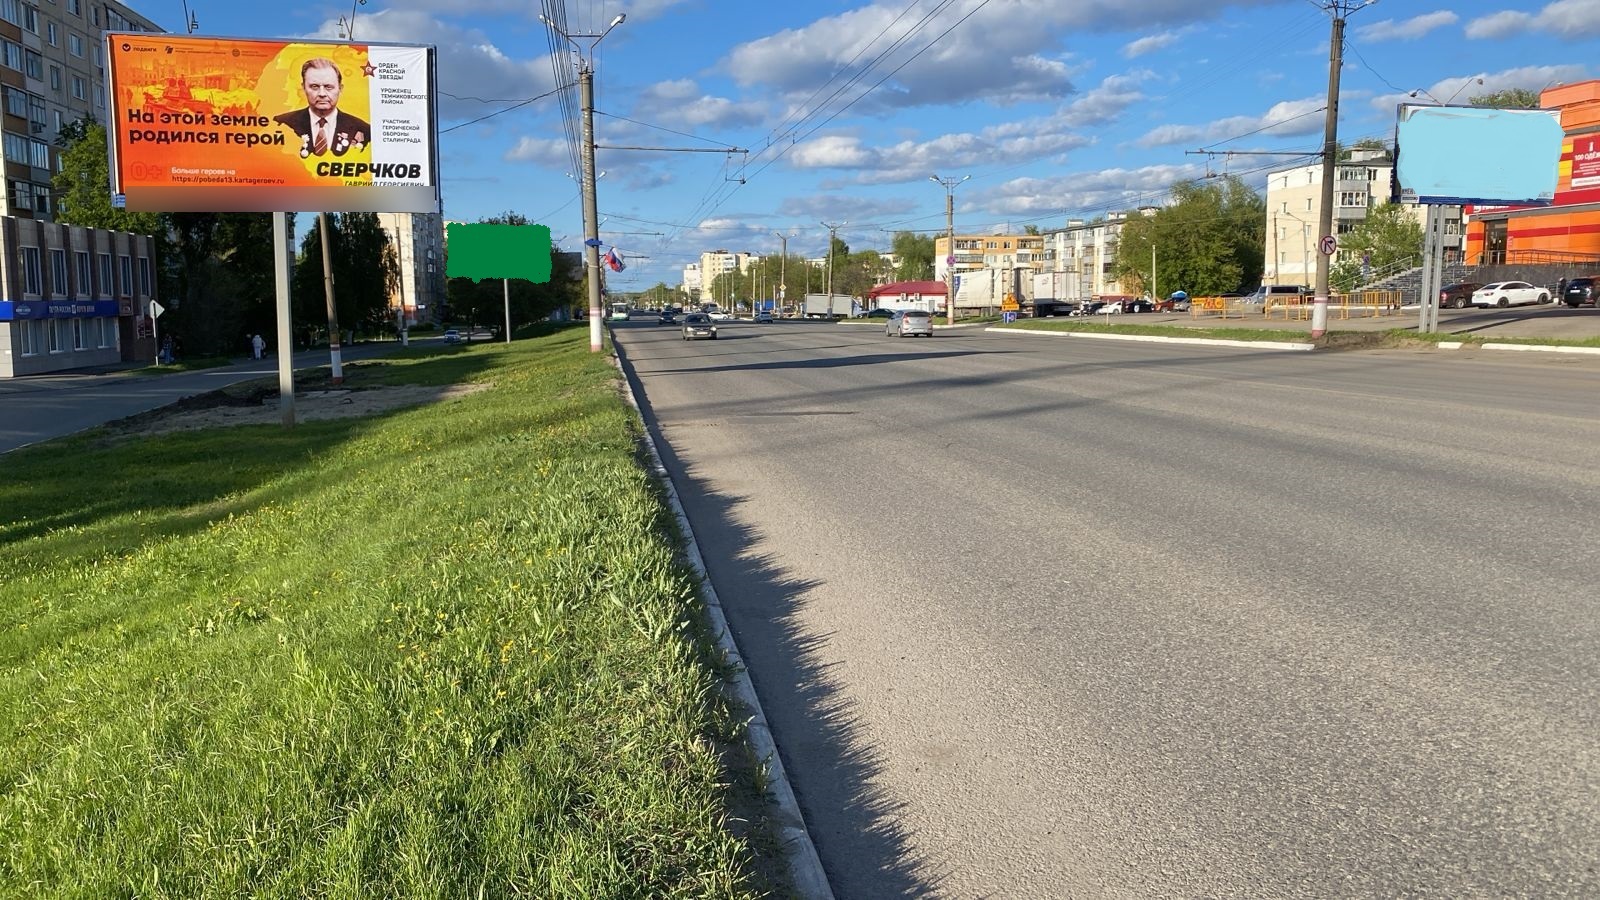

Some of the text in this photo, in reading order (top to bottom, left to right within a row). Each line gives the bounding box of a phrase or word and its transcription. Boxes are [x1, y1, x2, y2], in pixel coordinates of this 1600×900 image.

[128, 109, 270, 127] На этой земле
[130, 129, 285, 148] родился герой
[201, 168, 226, 176] героев
[317, 162, 421, 178] СВЕРЧКОВ
